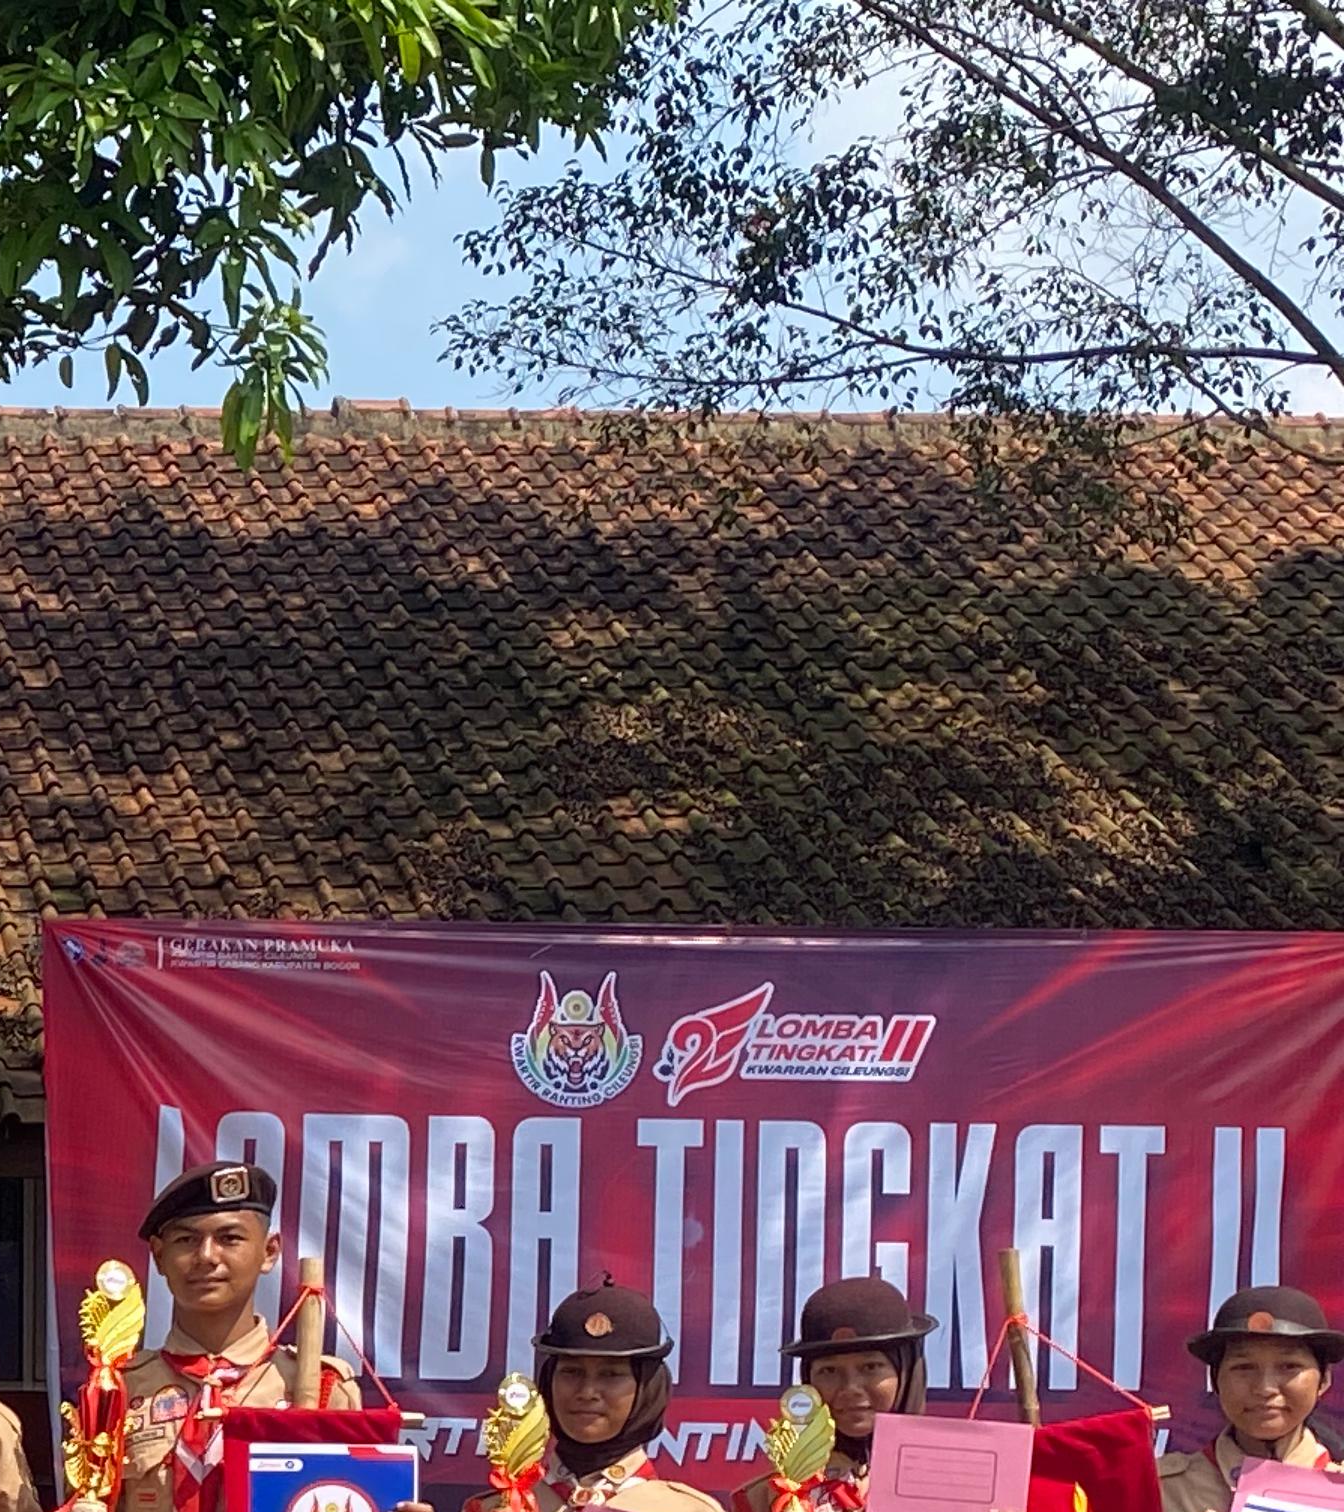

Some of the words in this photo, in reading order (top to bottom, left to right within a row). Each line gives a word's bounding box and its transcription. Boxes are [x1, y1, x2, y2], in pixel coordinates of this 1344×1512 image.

[170, 938, 258, 951] GERAKAN
[263, 938, 354, 952] PRAMUKA
[755, 1019, 878, 1041] LOMBA
[751, 1043, 879, 1063] TINGKAT
[514, 1036, 542, 1091] KWARTIR
[541, 1086, 602, 1105] RANTING
[604, 1038, 640, 1097] CILEUNGSI
[745, 1066, 829, 1076] KWARRAN
[830, 1066, 911, 1077] CILEUNGSI
